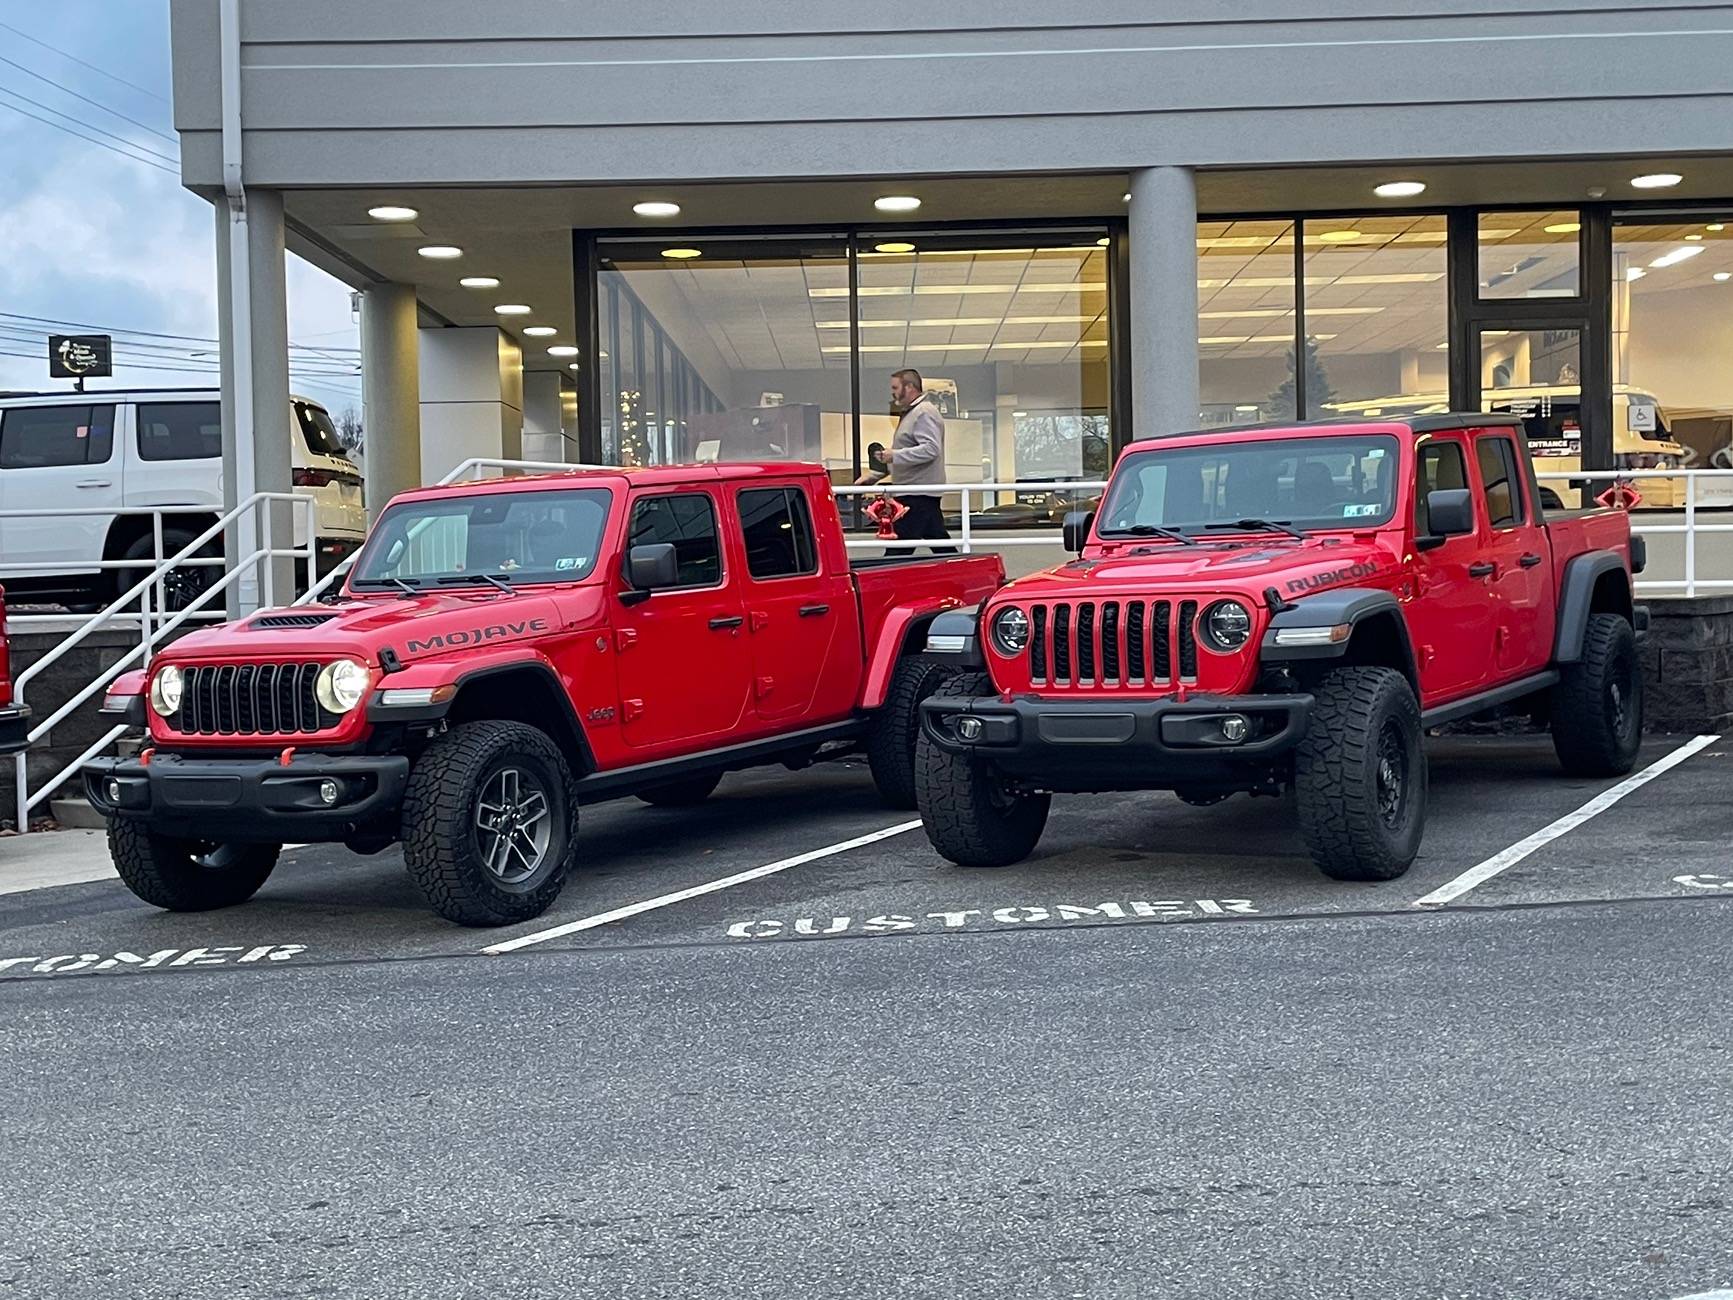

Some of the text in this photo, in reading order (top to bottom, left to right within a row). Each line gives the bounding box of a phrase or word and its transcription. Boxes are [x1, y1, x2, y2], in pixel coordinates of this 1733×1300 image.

[1527, 440, 1568, 448] ENTRANCE
[1286, 561, 1377, 593] RUBICON
[407, 618, 548, 653] MOJAVE
[726, 899, 1260, 938] CUSTOMER
